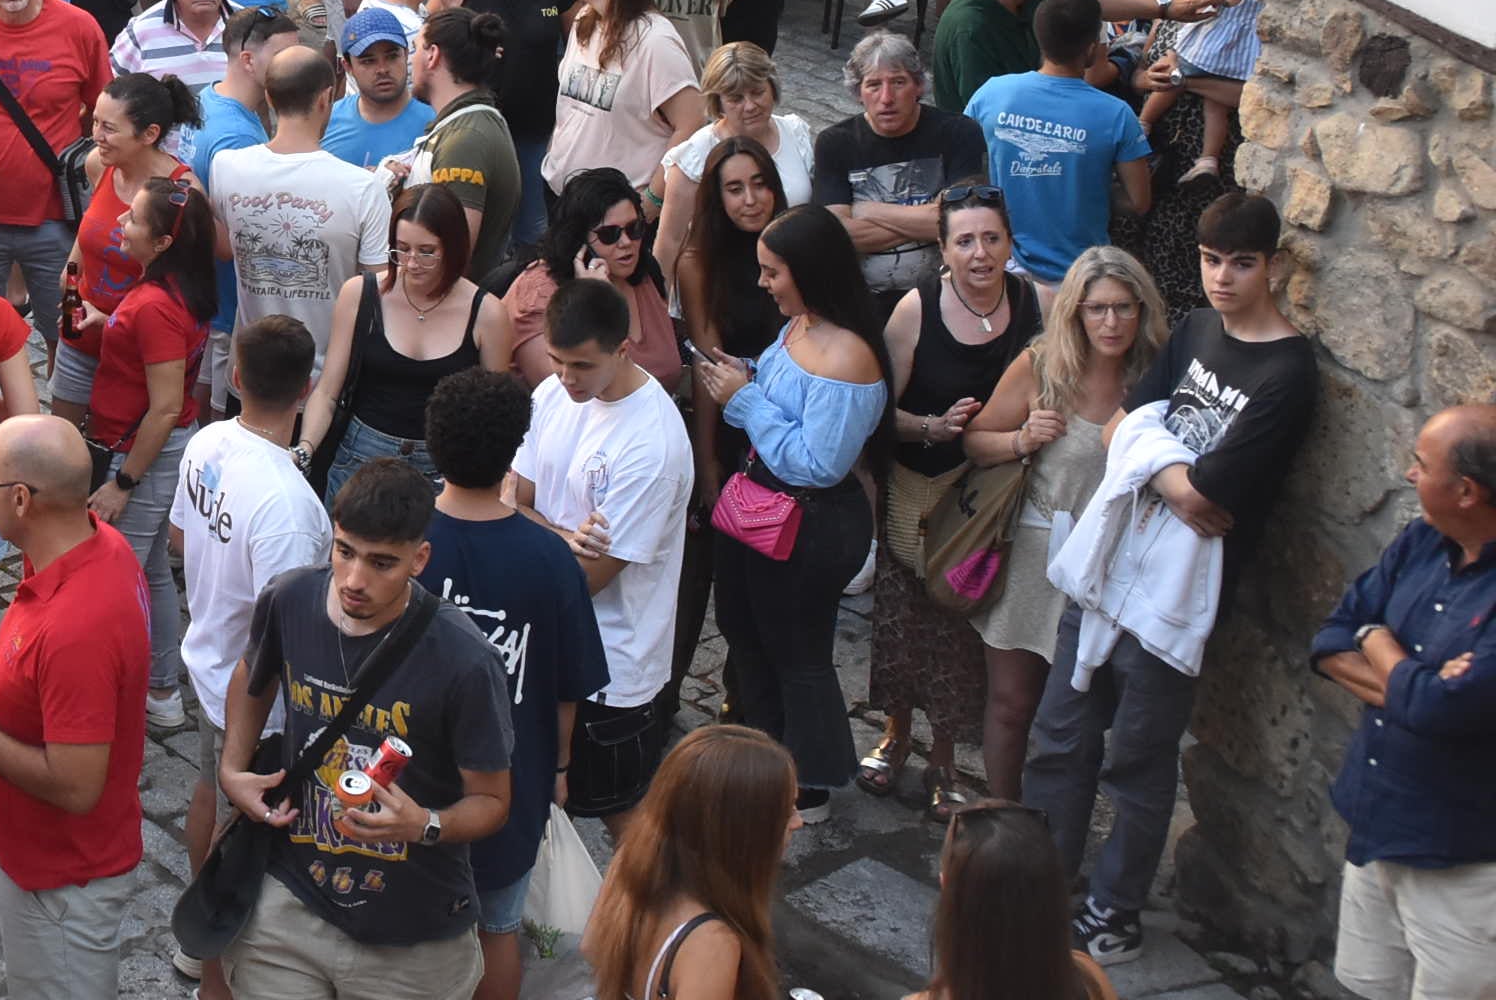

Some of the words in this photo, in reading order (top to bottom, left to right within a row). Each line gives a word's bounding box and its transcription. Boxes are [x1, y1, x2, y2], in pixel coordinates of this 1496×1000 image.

[997, 111, 1087, 142] CANDELARIO
[230, 193, 274, 212] Pool
[275, 192, 334, 224] Party
